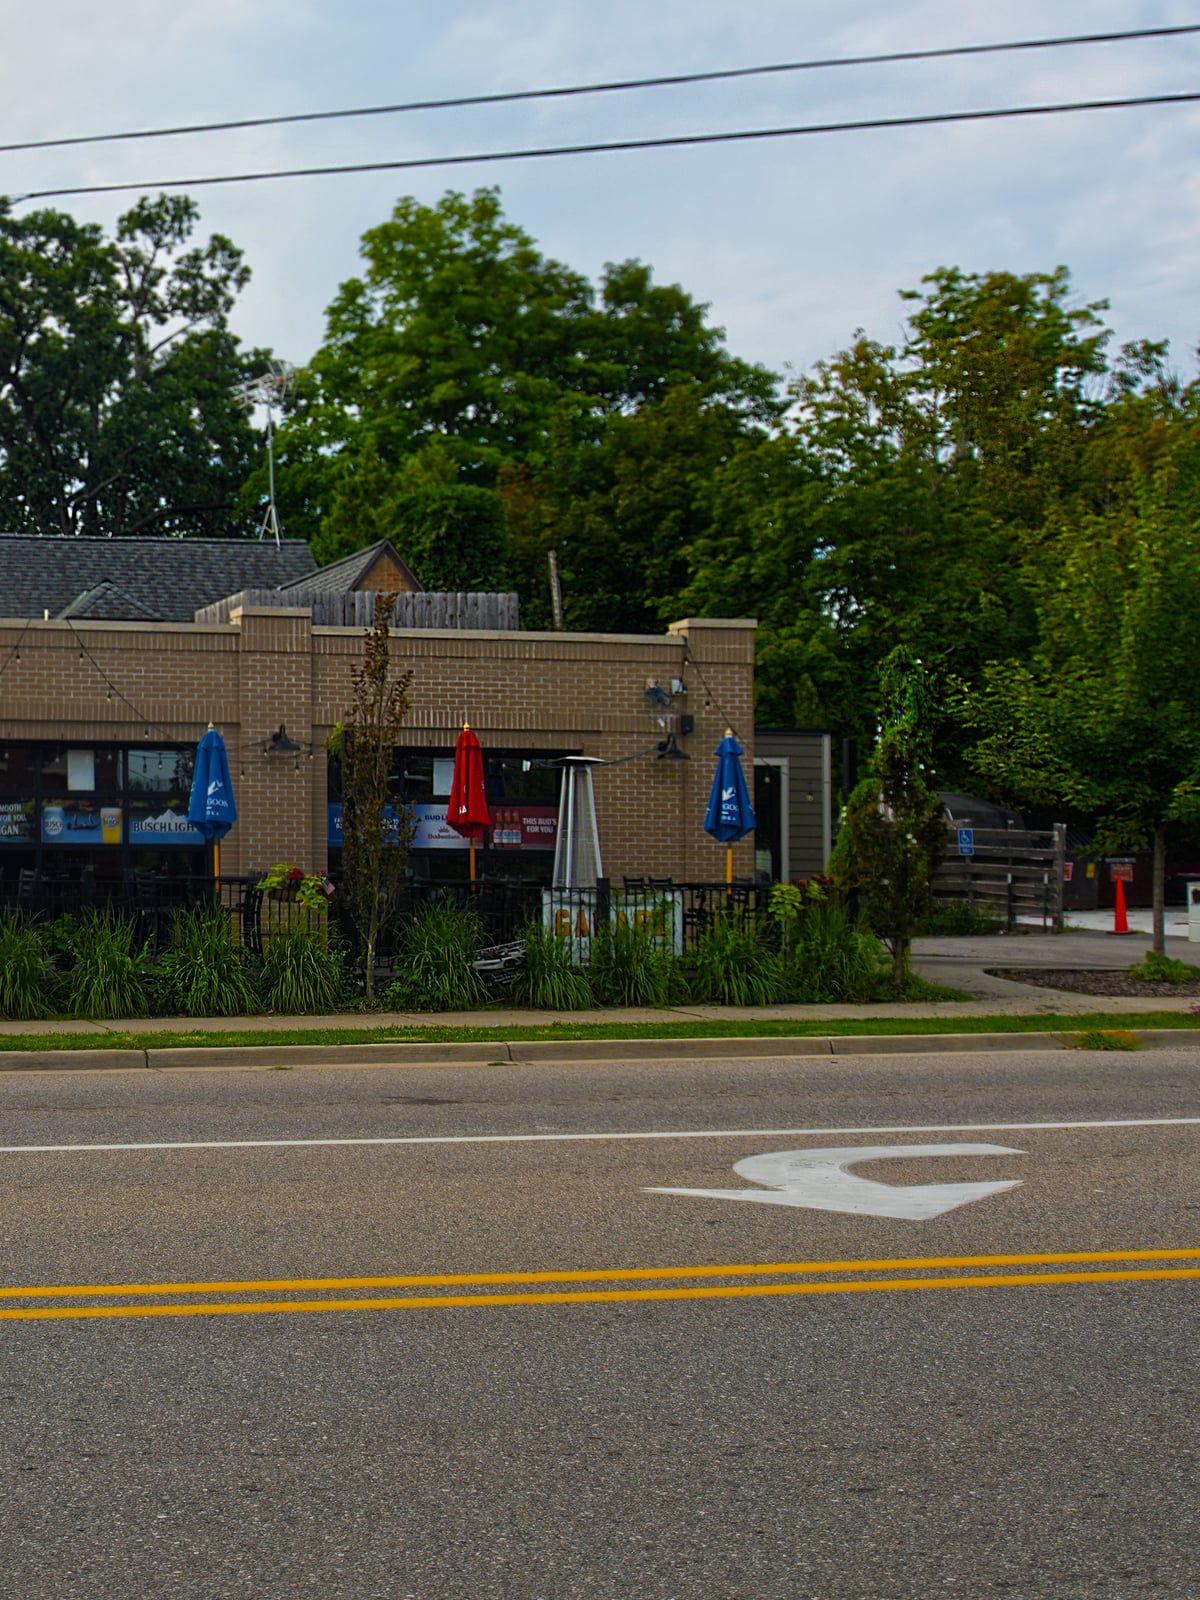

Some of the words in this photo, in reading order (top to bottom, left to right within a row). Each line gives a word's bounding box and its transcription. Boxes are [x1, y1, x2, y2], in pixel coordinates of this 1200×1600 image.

[0, 814, 12, 822] FOR
[522, 817, 537, 825] THIS
[538, 817, 557, 826] BUD'S
[168, 821, 195, 833] LIGH
[526, 825, 539, 833] FOR
[540, 825, 554, 833] YOU
[555, 909, 671, 937] GAAGE
